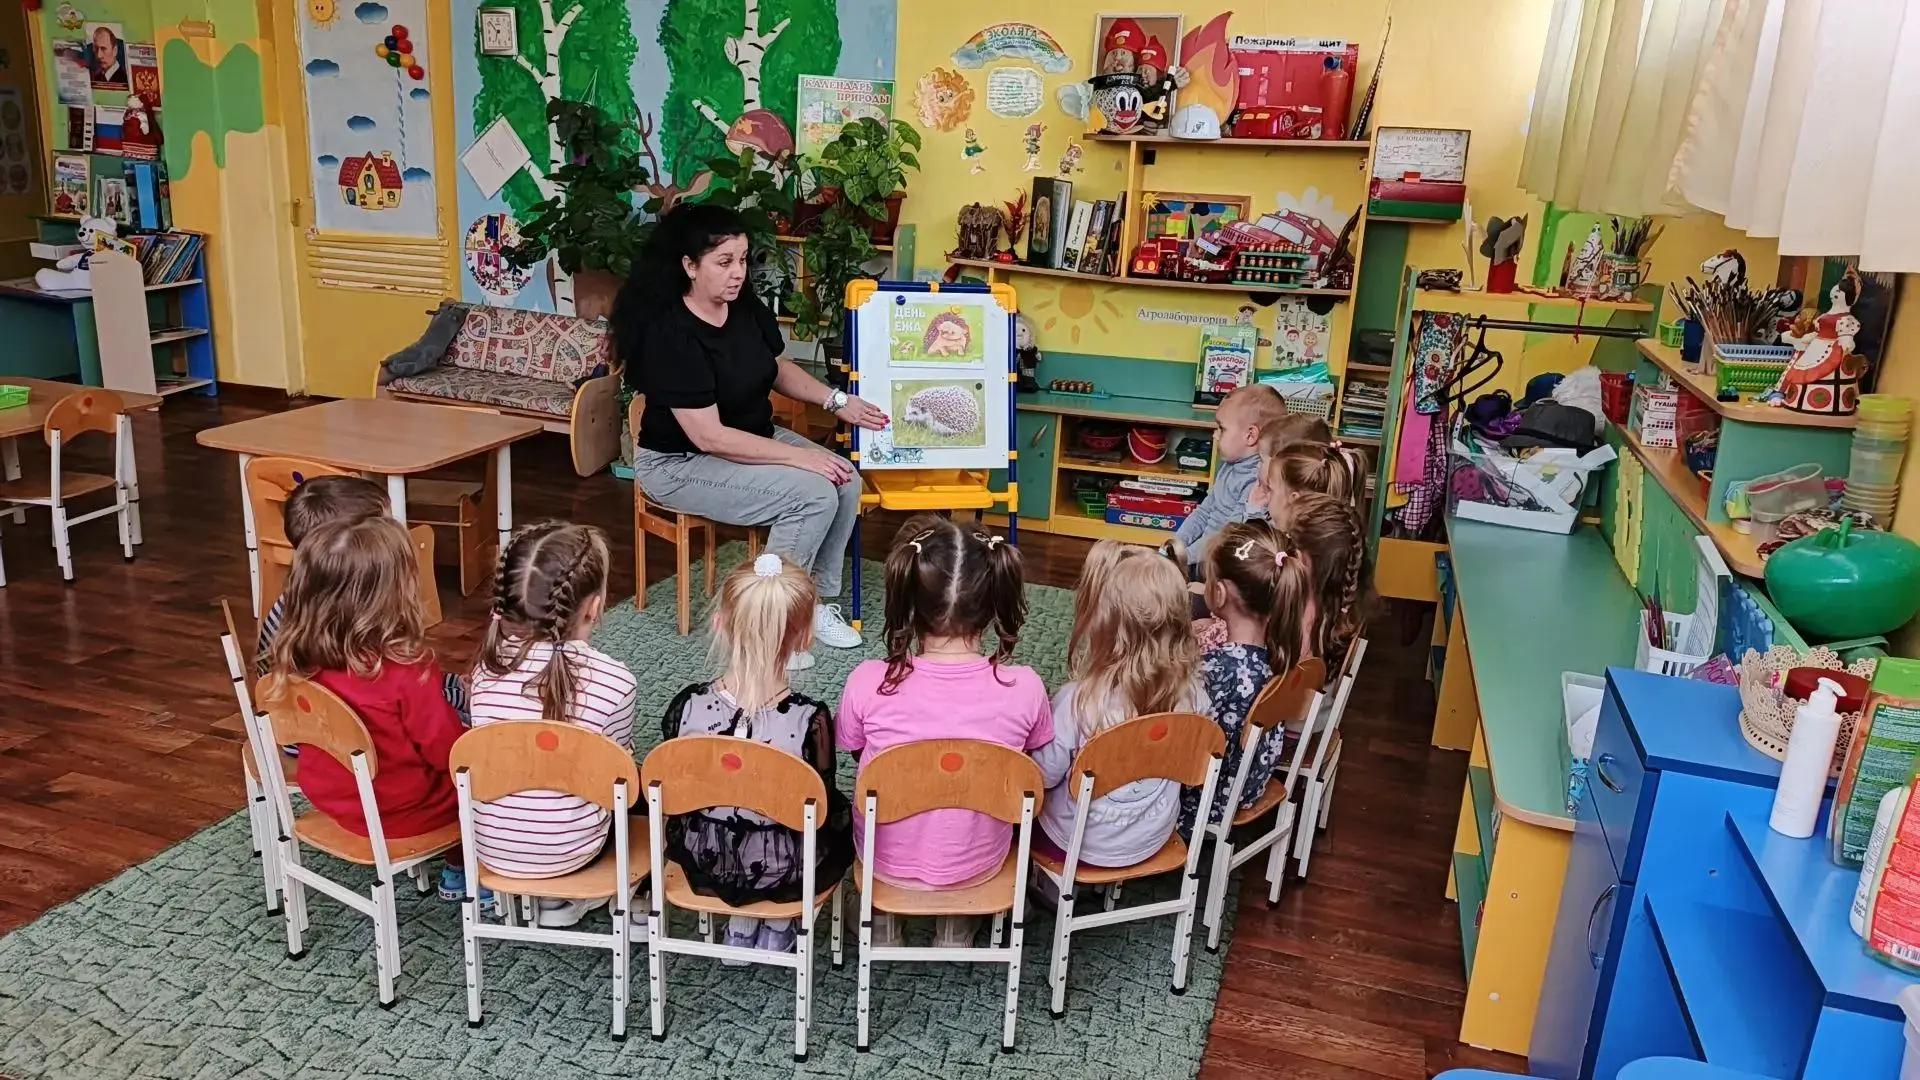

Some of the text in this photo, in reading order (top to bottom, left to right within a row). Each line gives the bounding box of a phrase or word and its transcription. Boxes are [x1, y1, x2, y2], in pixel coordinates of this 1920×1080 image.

[988, 27, 1037, 40] ЭКОЛЯТА
[1235, 36, 1296, 47] Пожарный
[804, 79, 873, 92] КАЛЕНДАРЬ
[837, 92, 889, 104] ПРИРОДЫ
[895, 307, 925, 318] ДЕНЬ
[1138, 308, 1227, 325] Агролаборатория
[896, 321, 921, 331] ЕЖА
[1208, 355, 1247, 366] ТРАНСПОРТ
